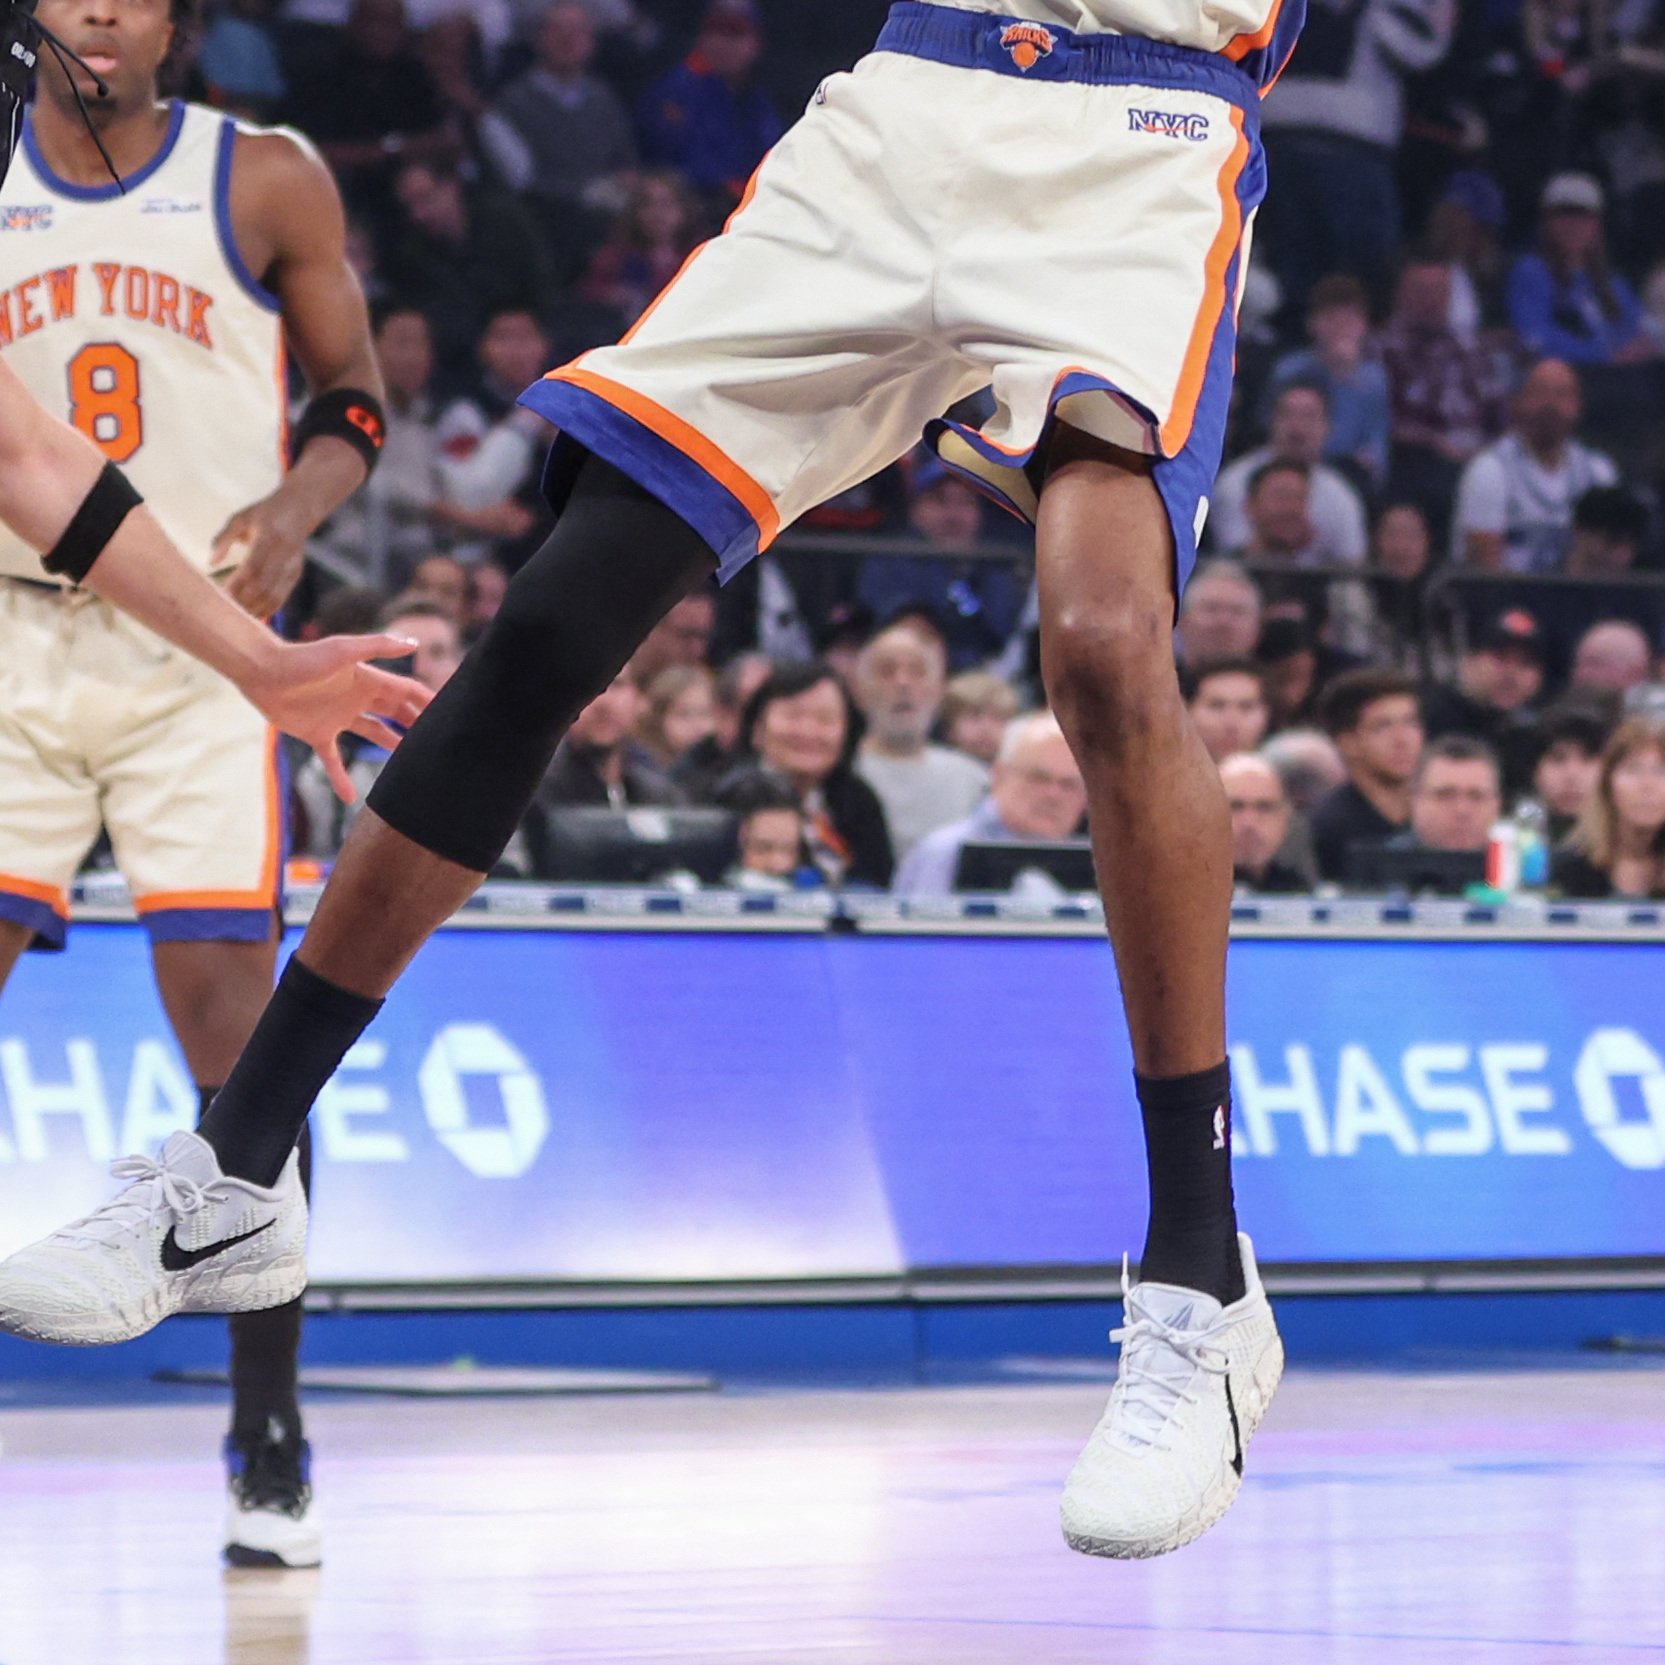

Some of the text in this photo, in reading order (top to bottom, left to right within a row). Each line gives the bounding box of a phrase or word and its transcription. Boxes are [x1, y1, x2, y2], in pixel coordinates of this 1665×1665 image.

[1127, 108, 1209, 141] NYC
[91, 261, 213, 350] YORK
[66, 341, 143, 464] 8
[1229, 1043, 1572, 1157] HASE
